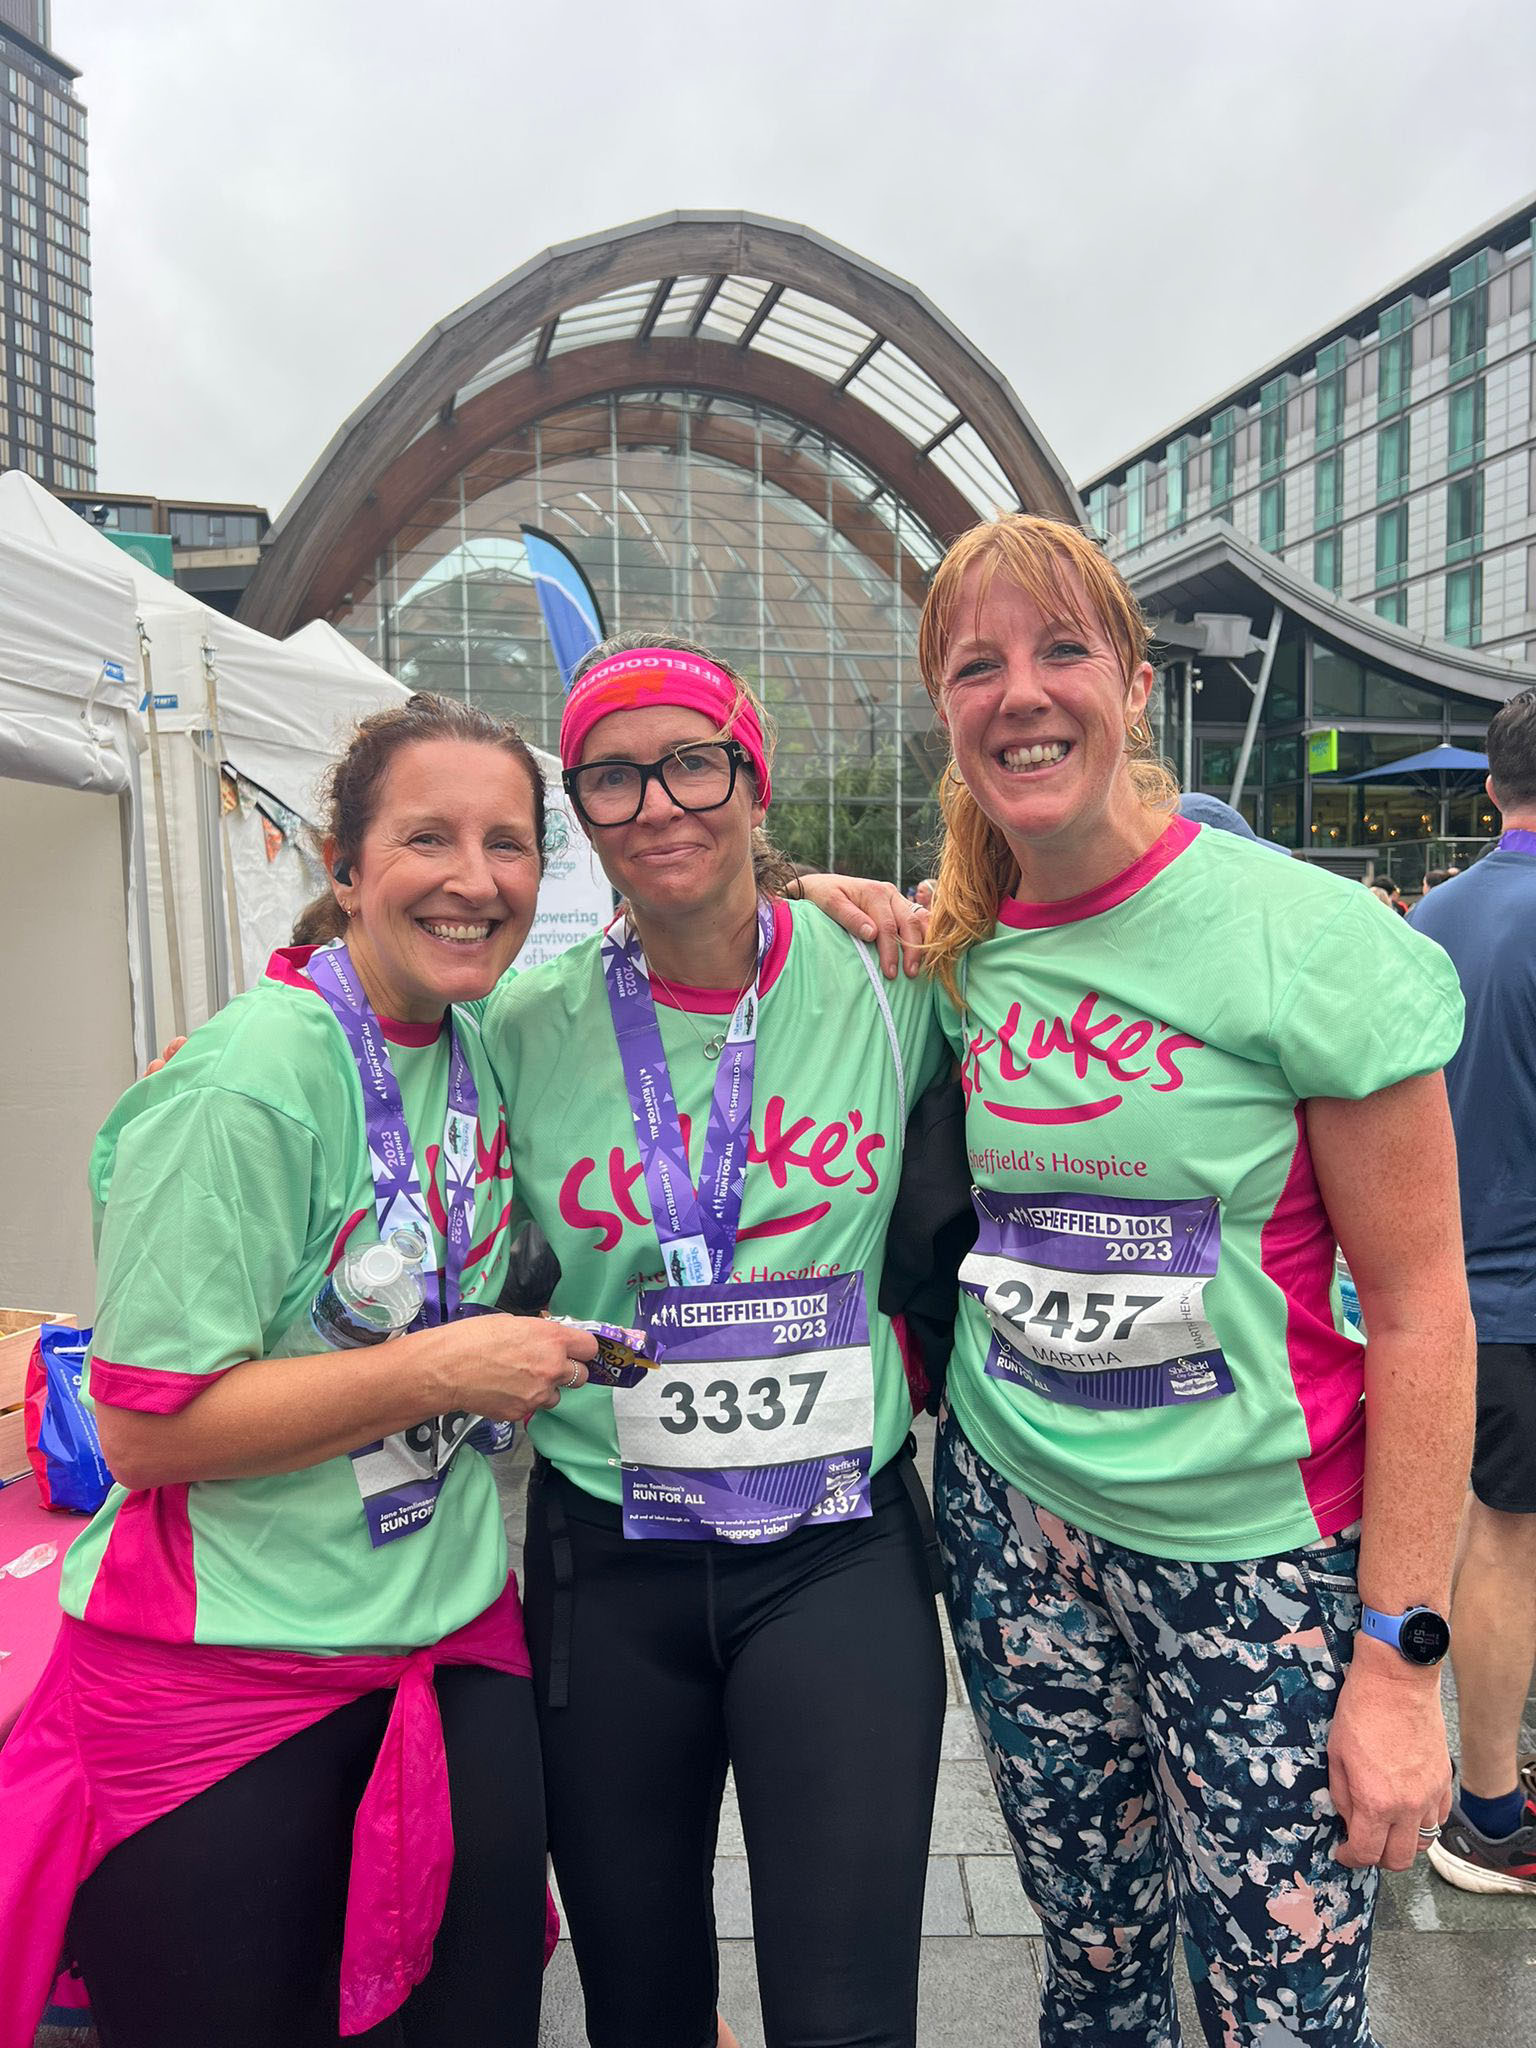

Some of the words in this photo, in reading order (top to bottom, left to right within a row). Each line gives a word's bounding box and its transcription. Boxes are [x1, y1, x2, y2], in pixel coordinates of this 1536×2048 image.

[533, 909, 598, 928] powering
[615, 968, 626, 998] FINISHER
[622, 966, 637, 996] 2023
[361, 1022, 371, 1038] ALL
[366, 1039, 379, 1058] FOR
[997, 991, 1206, 1092] Luke's
[371, 1059, 384, 1077] RUN
[733, 1051, 743, 1066] 10K
[641, 1087, 653, 1106] RUN
[730, 1067, 742, 1109] SHEFFIELD
[645, 1106, 656, 1125] FOR
[649, 1124, 659, 1140] ALL
[380, 1131, 399, 1168] 2023
[392, 1130, 406, 1166] FINISHER
[723, 1141, 734, 1157] ALL
[721, 1157, 732, 1177] FOR
[969, 1149, 1046, 1175] Sheffield's
[1052, 1152, 1149, 1182] Hospice
[718, 1177, 730, 1197] RUN
[660, 1173, 676, 1216] SHEFFIELD
[668, 1215, 681, 1232] 10K
[1033, 1208, 1121, 1237] SHEFFIELD
[1125, 1217, 1170, 1237] 10K
[1105, 1240, 1174, 1262] 2023
[750, 1259, 841, 1284] Hospice
[683, 1301, 788, 1325] SHEFFIELD
[791, 1297, 825, 1317] 10K
[994, 1279, 1165, 1343] 2457
[772, 1318, 828, 1345] 2023
[996, 1356, 1019, 1374] RUN
[1031, 1346, 1123, 1368] MARTHA
[659, 1370, 829, 1435] 3337
[632, 1490, 657, 1502] RUN
[659, 1491, 682, 1504] FOR
[684, 1494, 706, 1505] ALL
[633, 1482, 648, 1490] Jane
[649, 1483, 685, 1493] Tomlinson's
[380, 1510, 397, 1522] Jane
[811, 1493, 862, 1517] 3337
[380, 1516, 409, 1534] RUN
[411, 1504, 436, 1523] FOR
[715, 1527, 762, 1539] Baggage
[763, 1521, 788, 1535] label
[1413, 1629, 1425, 1644] 50
